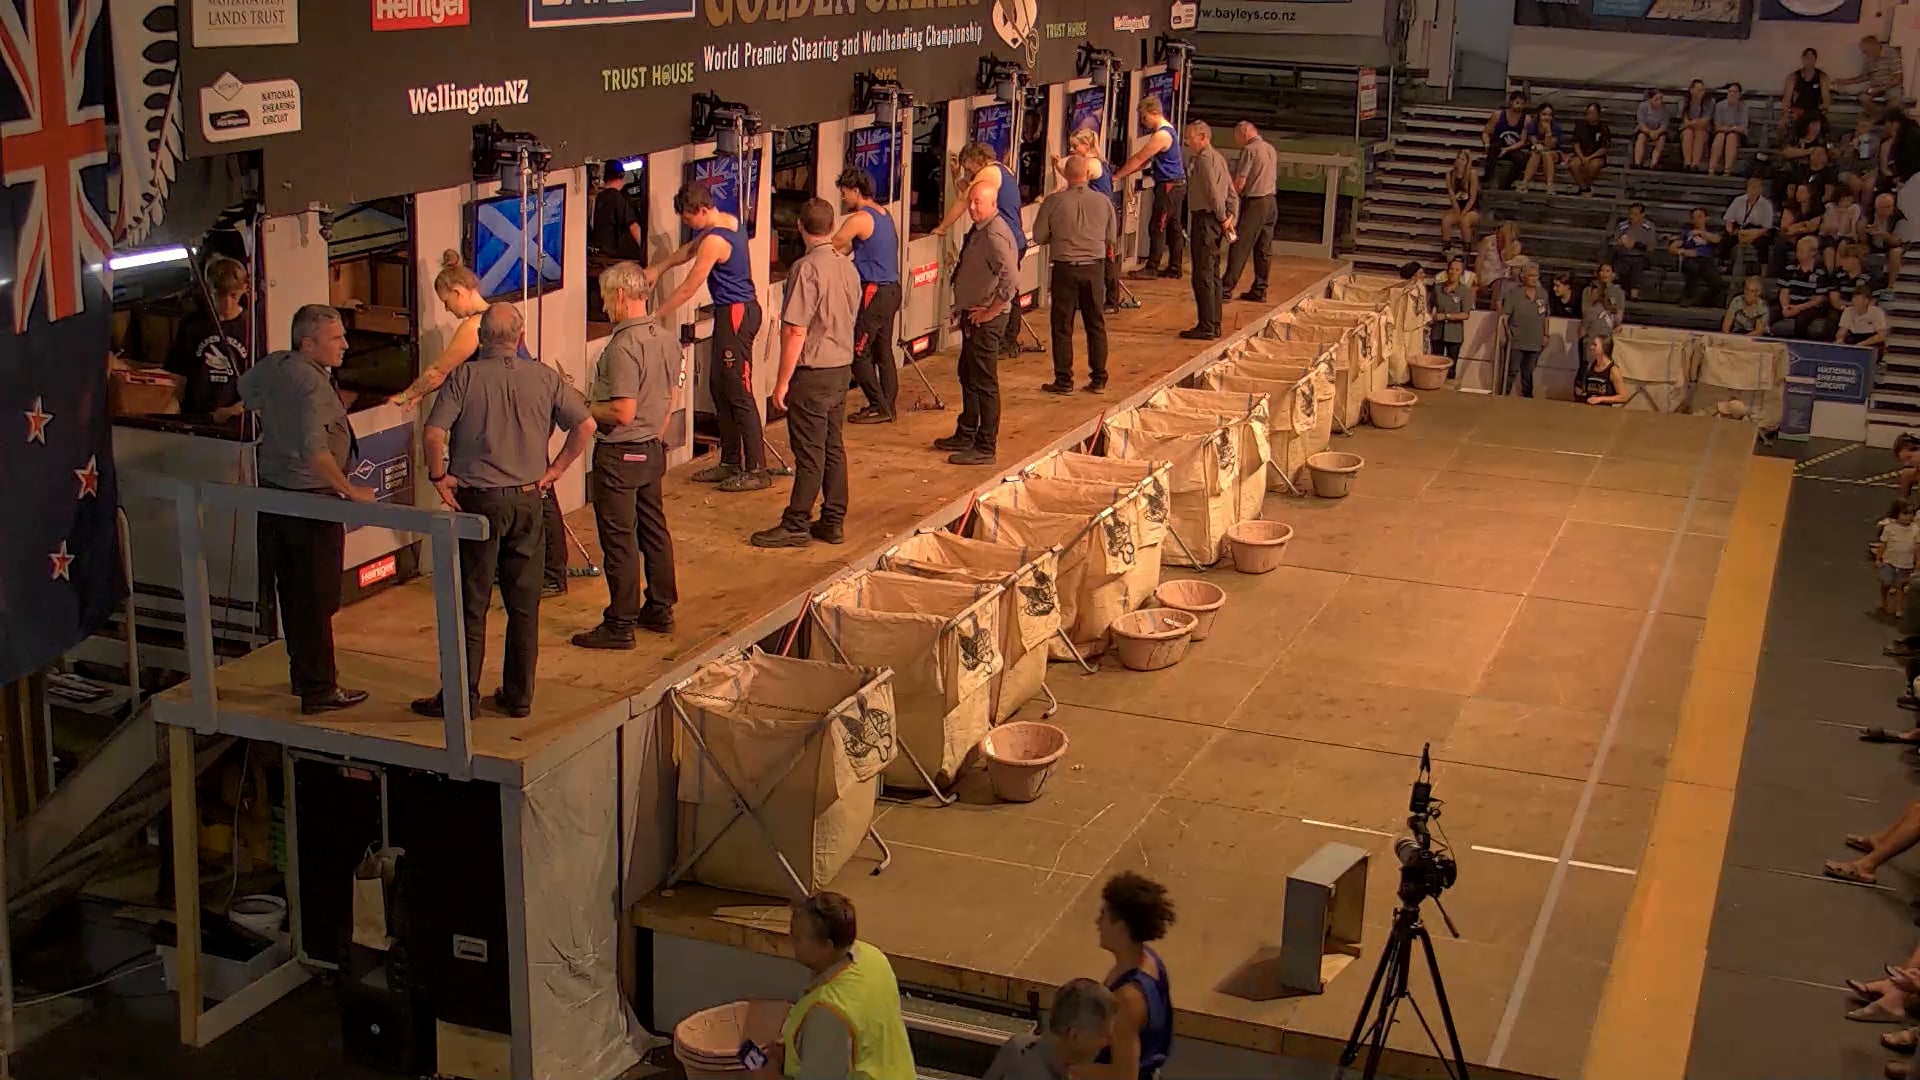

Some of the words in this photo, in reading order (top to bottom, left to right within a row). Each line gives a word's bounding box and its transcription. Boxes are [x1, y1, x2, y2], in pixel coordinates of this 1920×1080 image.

[208, 11, 247, 25] LANDS
[250, 10, 286, 24] TRUST
[1199, 8, 1296, 21] w.bayleys.co.nz
[704, 43, 738, 72] World
[745, 41, 788, 67] Premier
[792, 35, 838, 62] Shearing
[842, 32, 859, 55] and
[863, 27, 922, 51] Woolhandling
[926, 20, 982, 48] Championship
[602, 67, 647, 91] TRUST
[408, 79, 528, 115] WellingtonNZ
